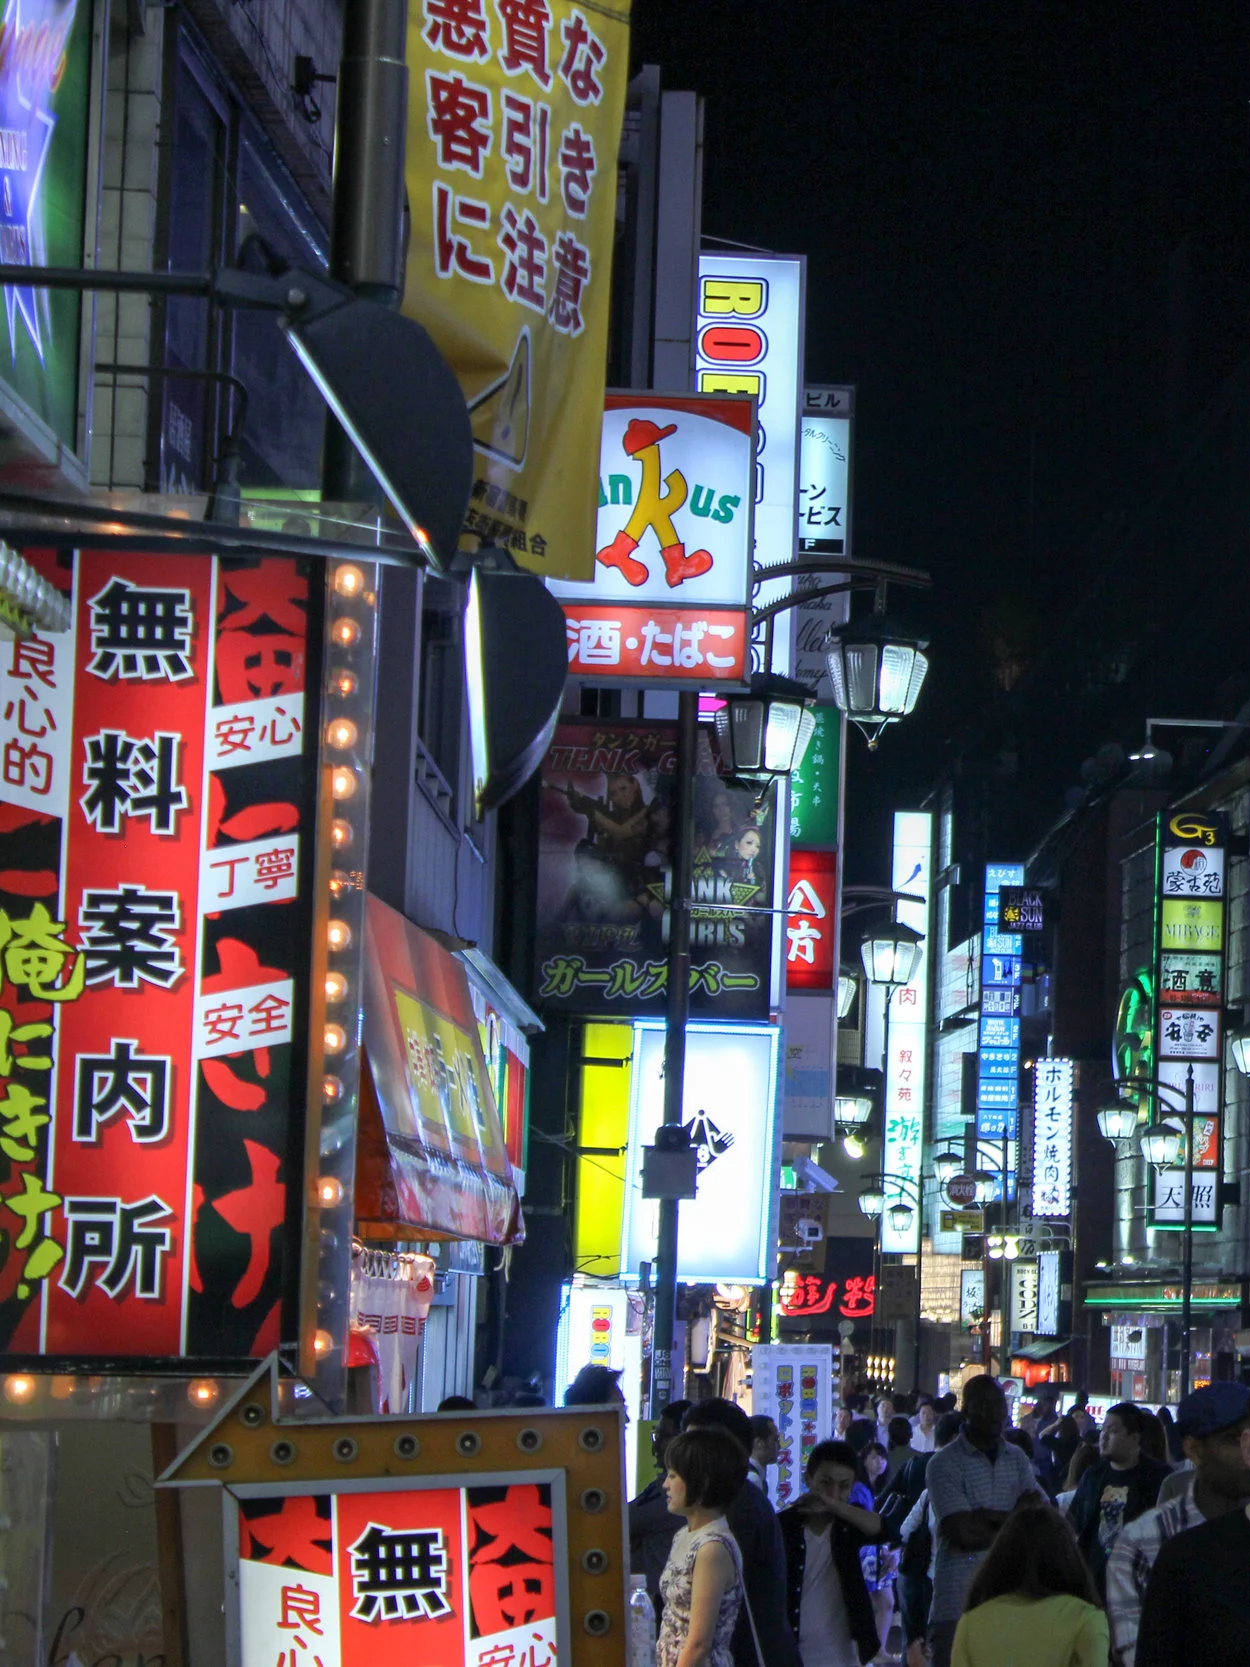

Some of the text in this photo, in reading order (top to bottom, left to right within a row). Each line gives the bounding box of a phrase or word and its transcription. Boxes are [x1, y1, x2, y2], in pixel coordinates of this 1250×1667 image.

[423, 0, 606, 103] 悪質な
[425, 72, 600, 218] 客引き
[432, 182, 592, 337] に注意
[2, 633, 57, 796] 良心的
[214, 706, 301, 757] 安心
[209, 847, 297, 898] 丁寧
[58, 576, 195, 1299] 無料案内所
[1020, 906, 1042, 922] SUN
[1165, 922, 1220, 938] MIRAGE
[203, 993, 291, 1046] 安全
[897, 1049, 914, 1102] 叙々苑
[1161, 1185, 1213, 1209] 天照
[346, 1522, 452, 1622] 無
